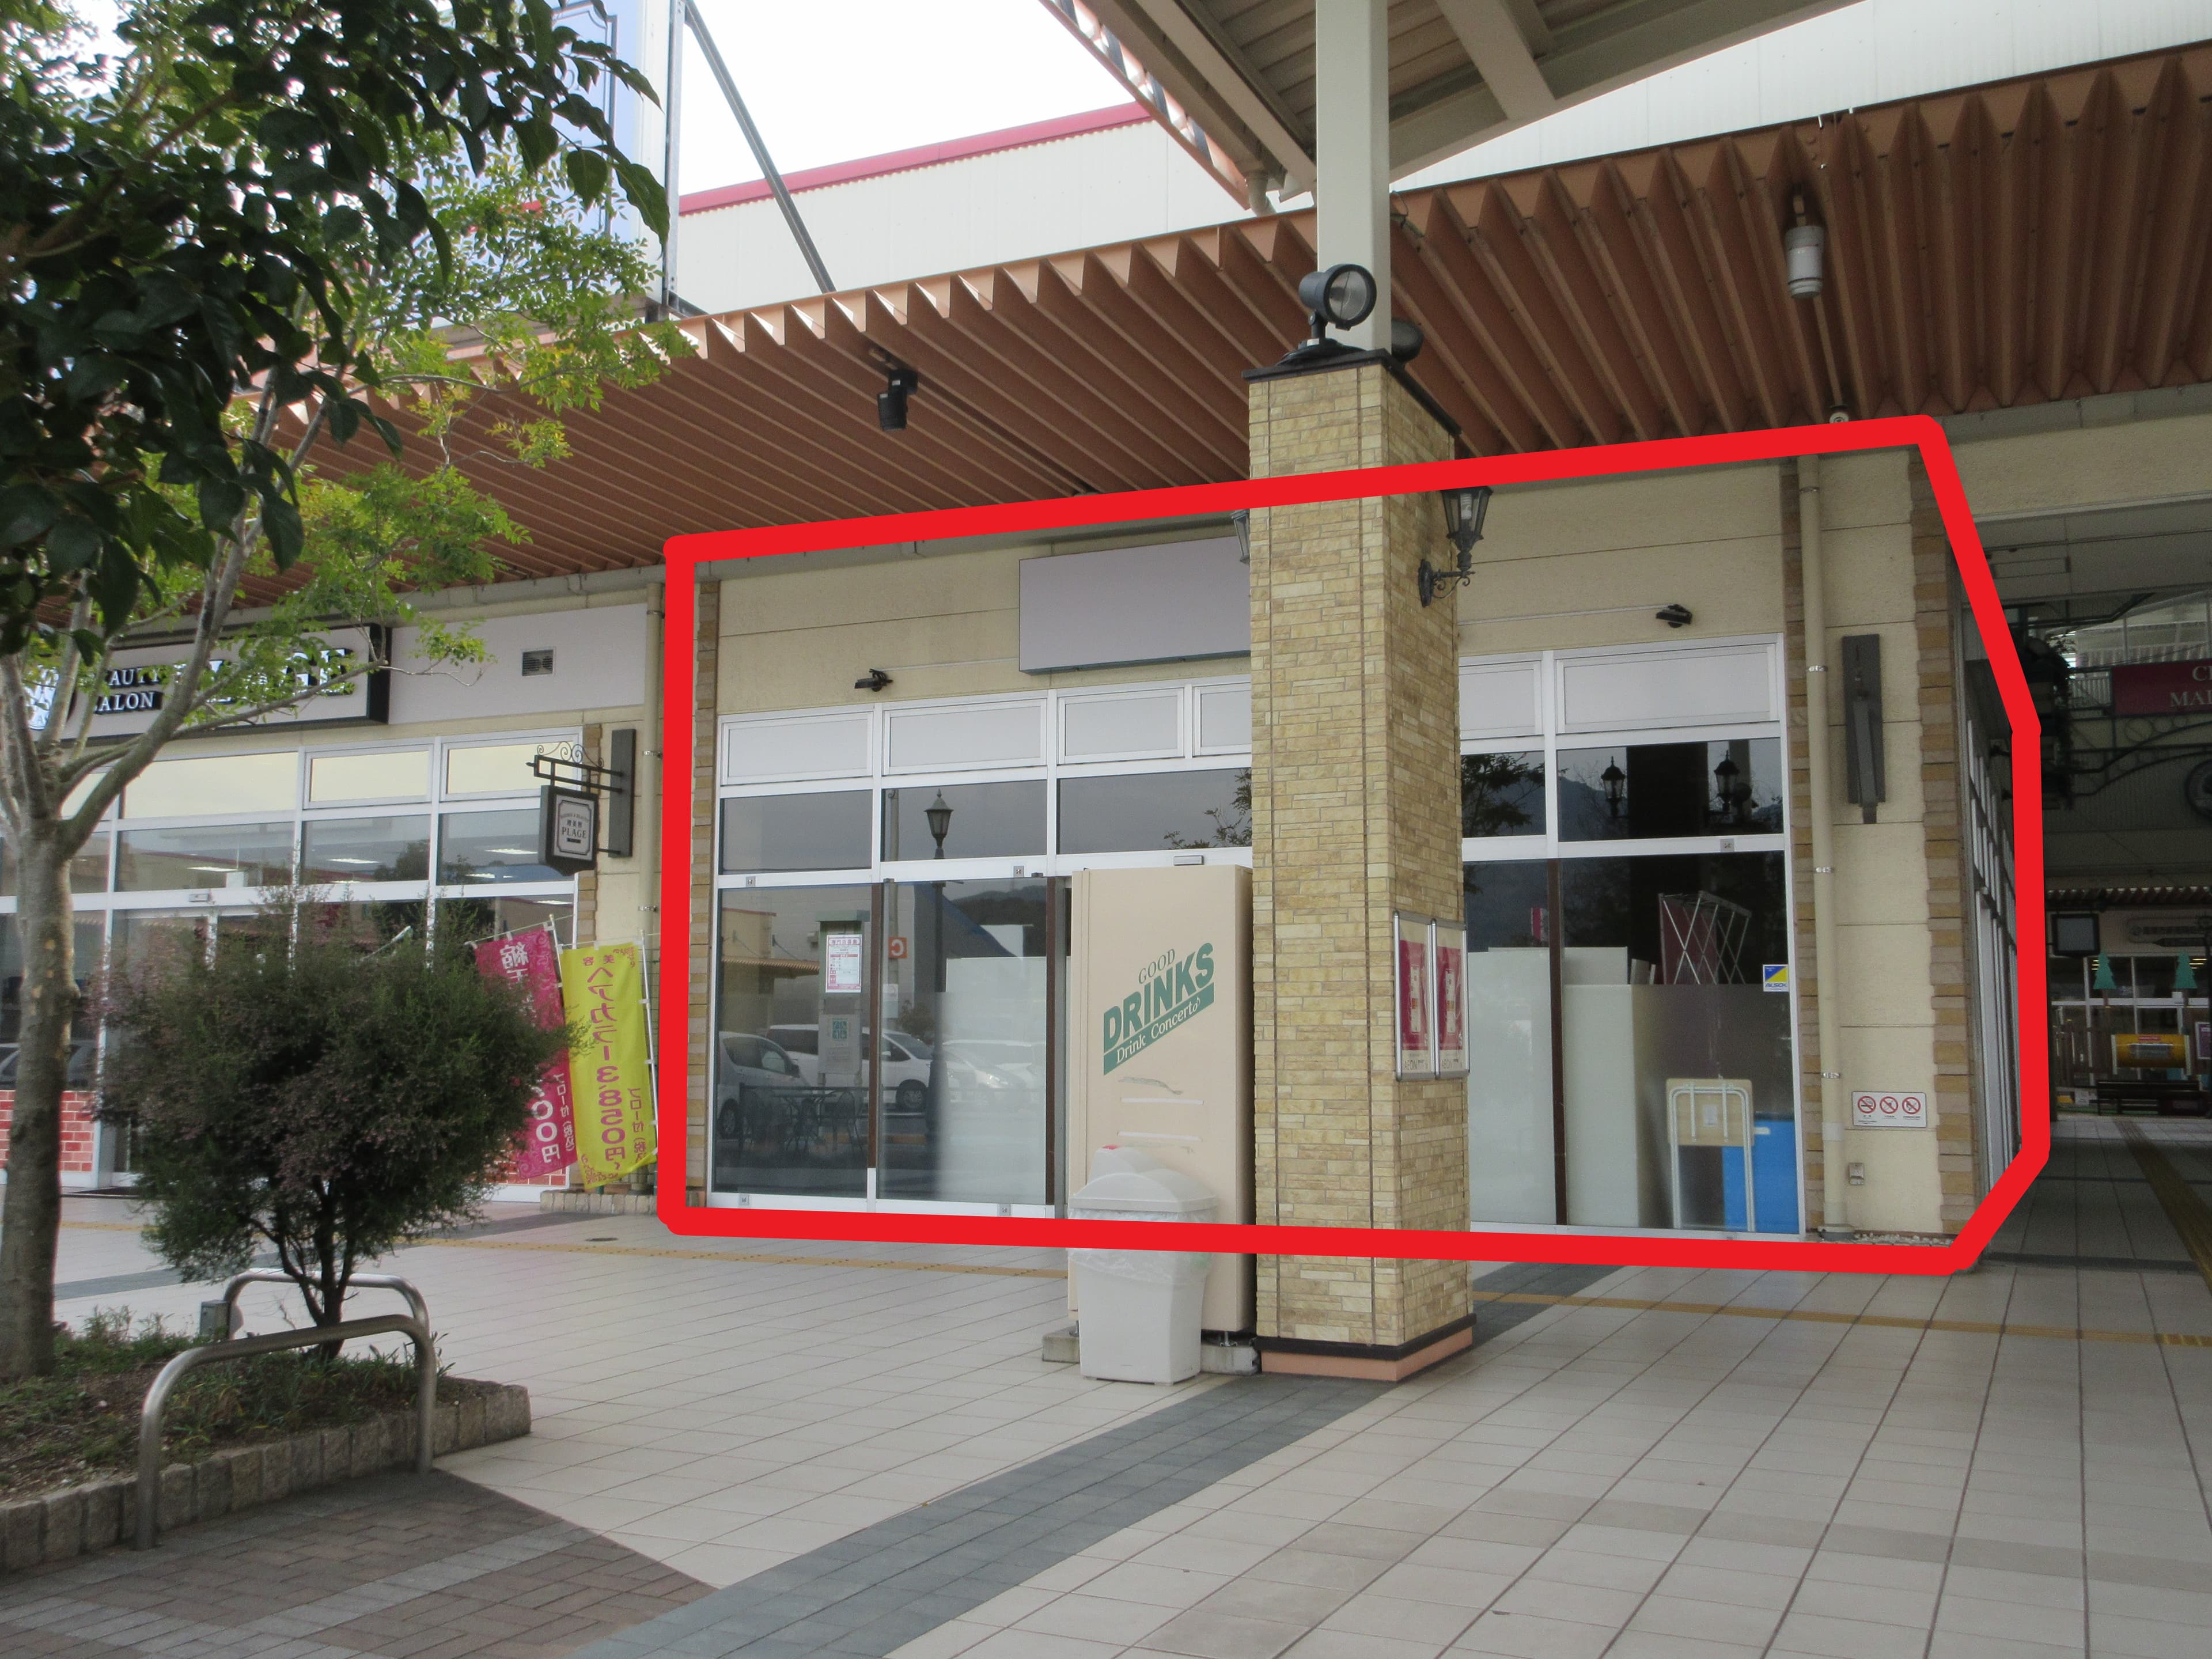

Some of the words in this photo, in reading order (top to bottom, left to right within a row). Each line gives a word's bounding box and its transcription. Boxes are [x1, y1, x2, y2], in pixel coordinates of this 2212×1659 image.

[94, 692, 154, 712] ALON
[562, 827, 586, 839] PLAGE
[1139, 949, 1176, 984] GOOD
[1103, 942, 1214, 1054] DRINKS
[1116, 1034, 1146, 1064] Drink
[1151, 998, 1200, 1039] Concerto
